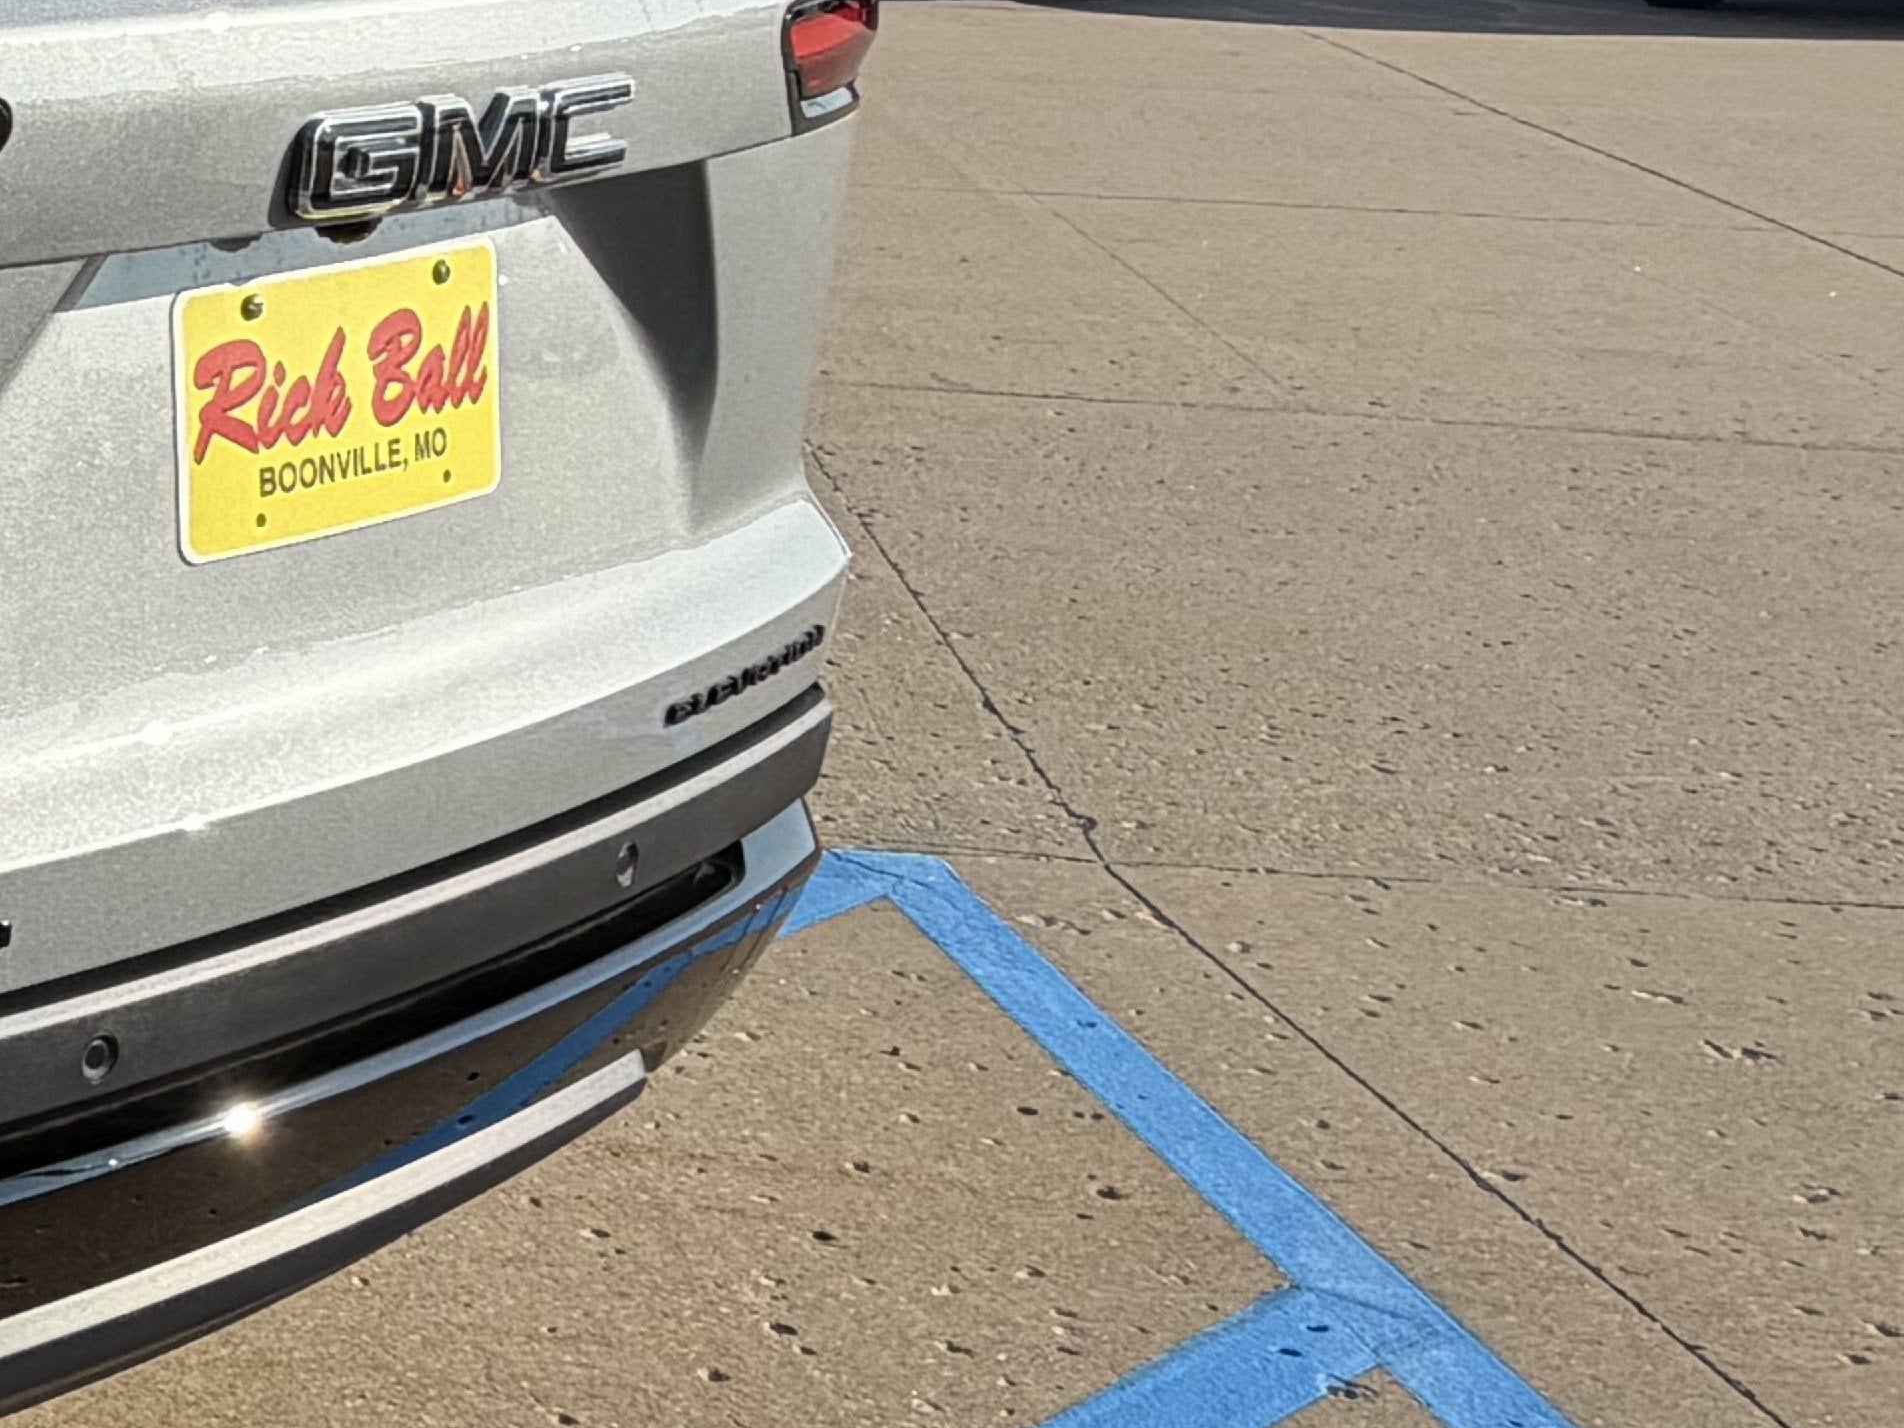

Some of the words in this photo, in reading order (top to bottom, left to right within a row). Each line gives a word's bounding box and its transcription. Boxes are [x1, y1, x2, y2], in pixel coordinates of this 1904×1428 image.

[294, 73, 636, 220] GMC
[193, 326, 352, 465] Rick
[367, 300, 490, 428] Ball
[259, 438, 409, 498] BOONVILLE,
[415, 427, 448, 462] MO
